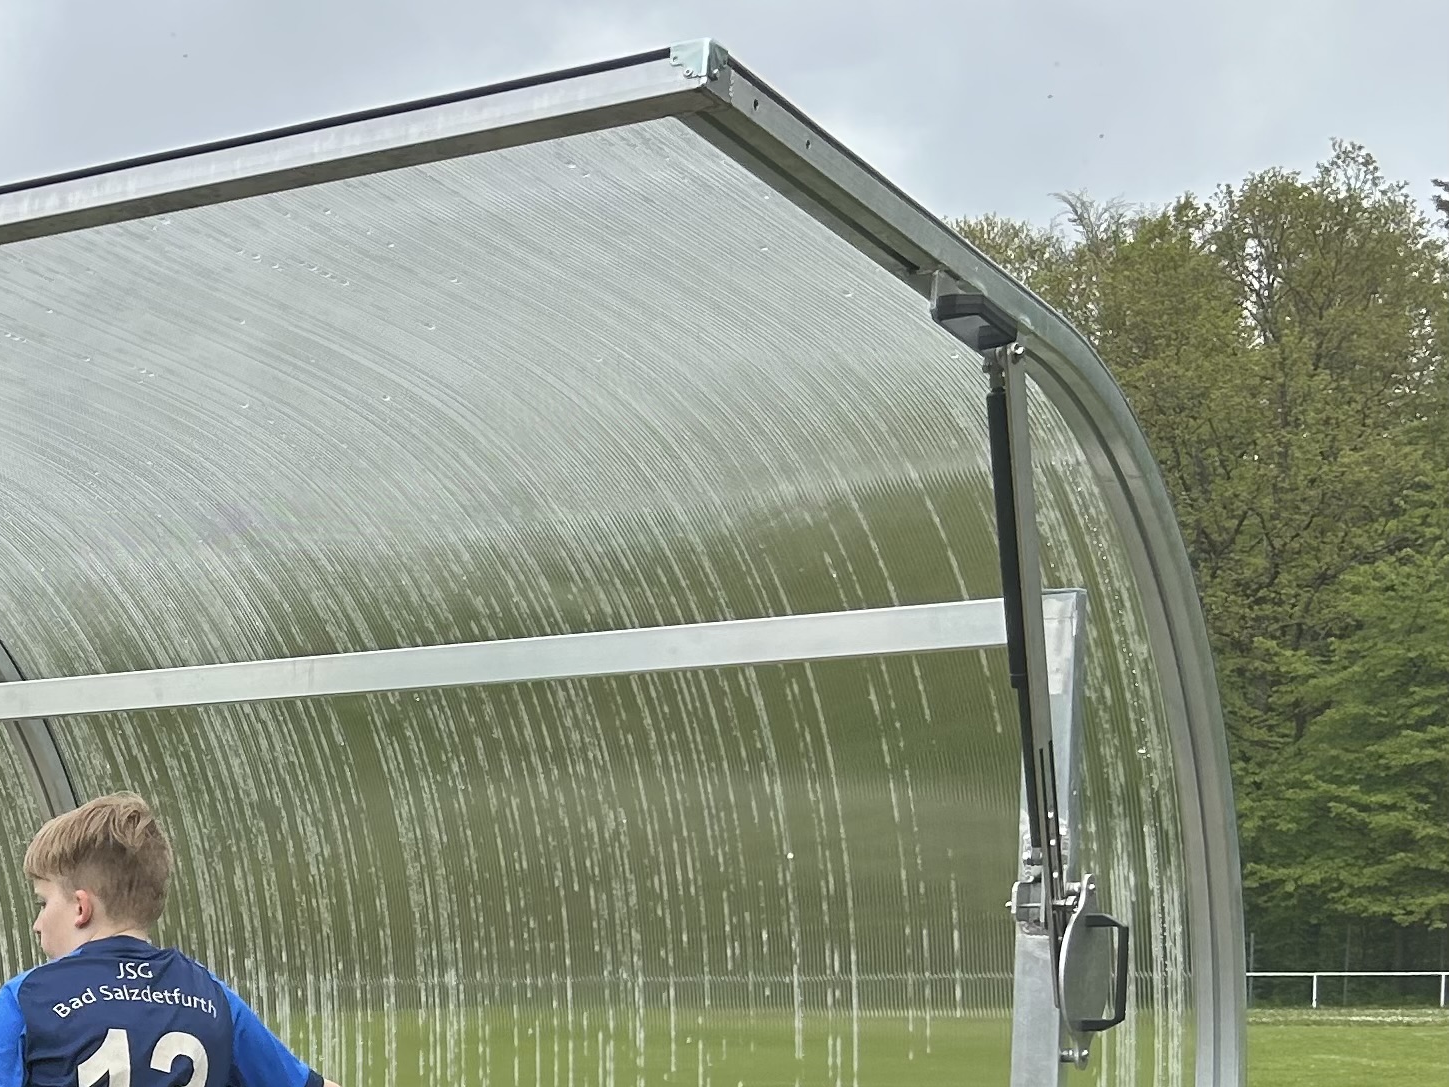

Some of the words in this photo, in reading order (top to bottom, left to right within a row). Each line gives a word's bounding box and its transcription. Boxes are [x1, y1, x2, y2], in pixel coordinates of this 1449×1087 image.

[116, 962, 154, 980] JSG
[52, 987, 98, 1019] Bad
[99, 984, 218, 1019] Salzdetfurth
